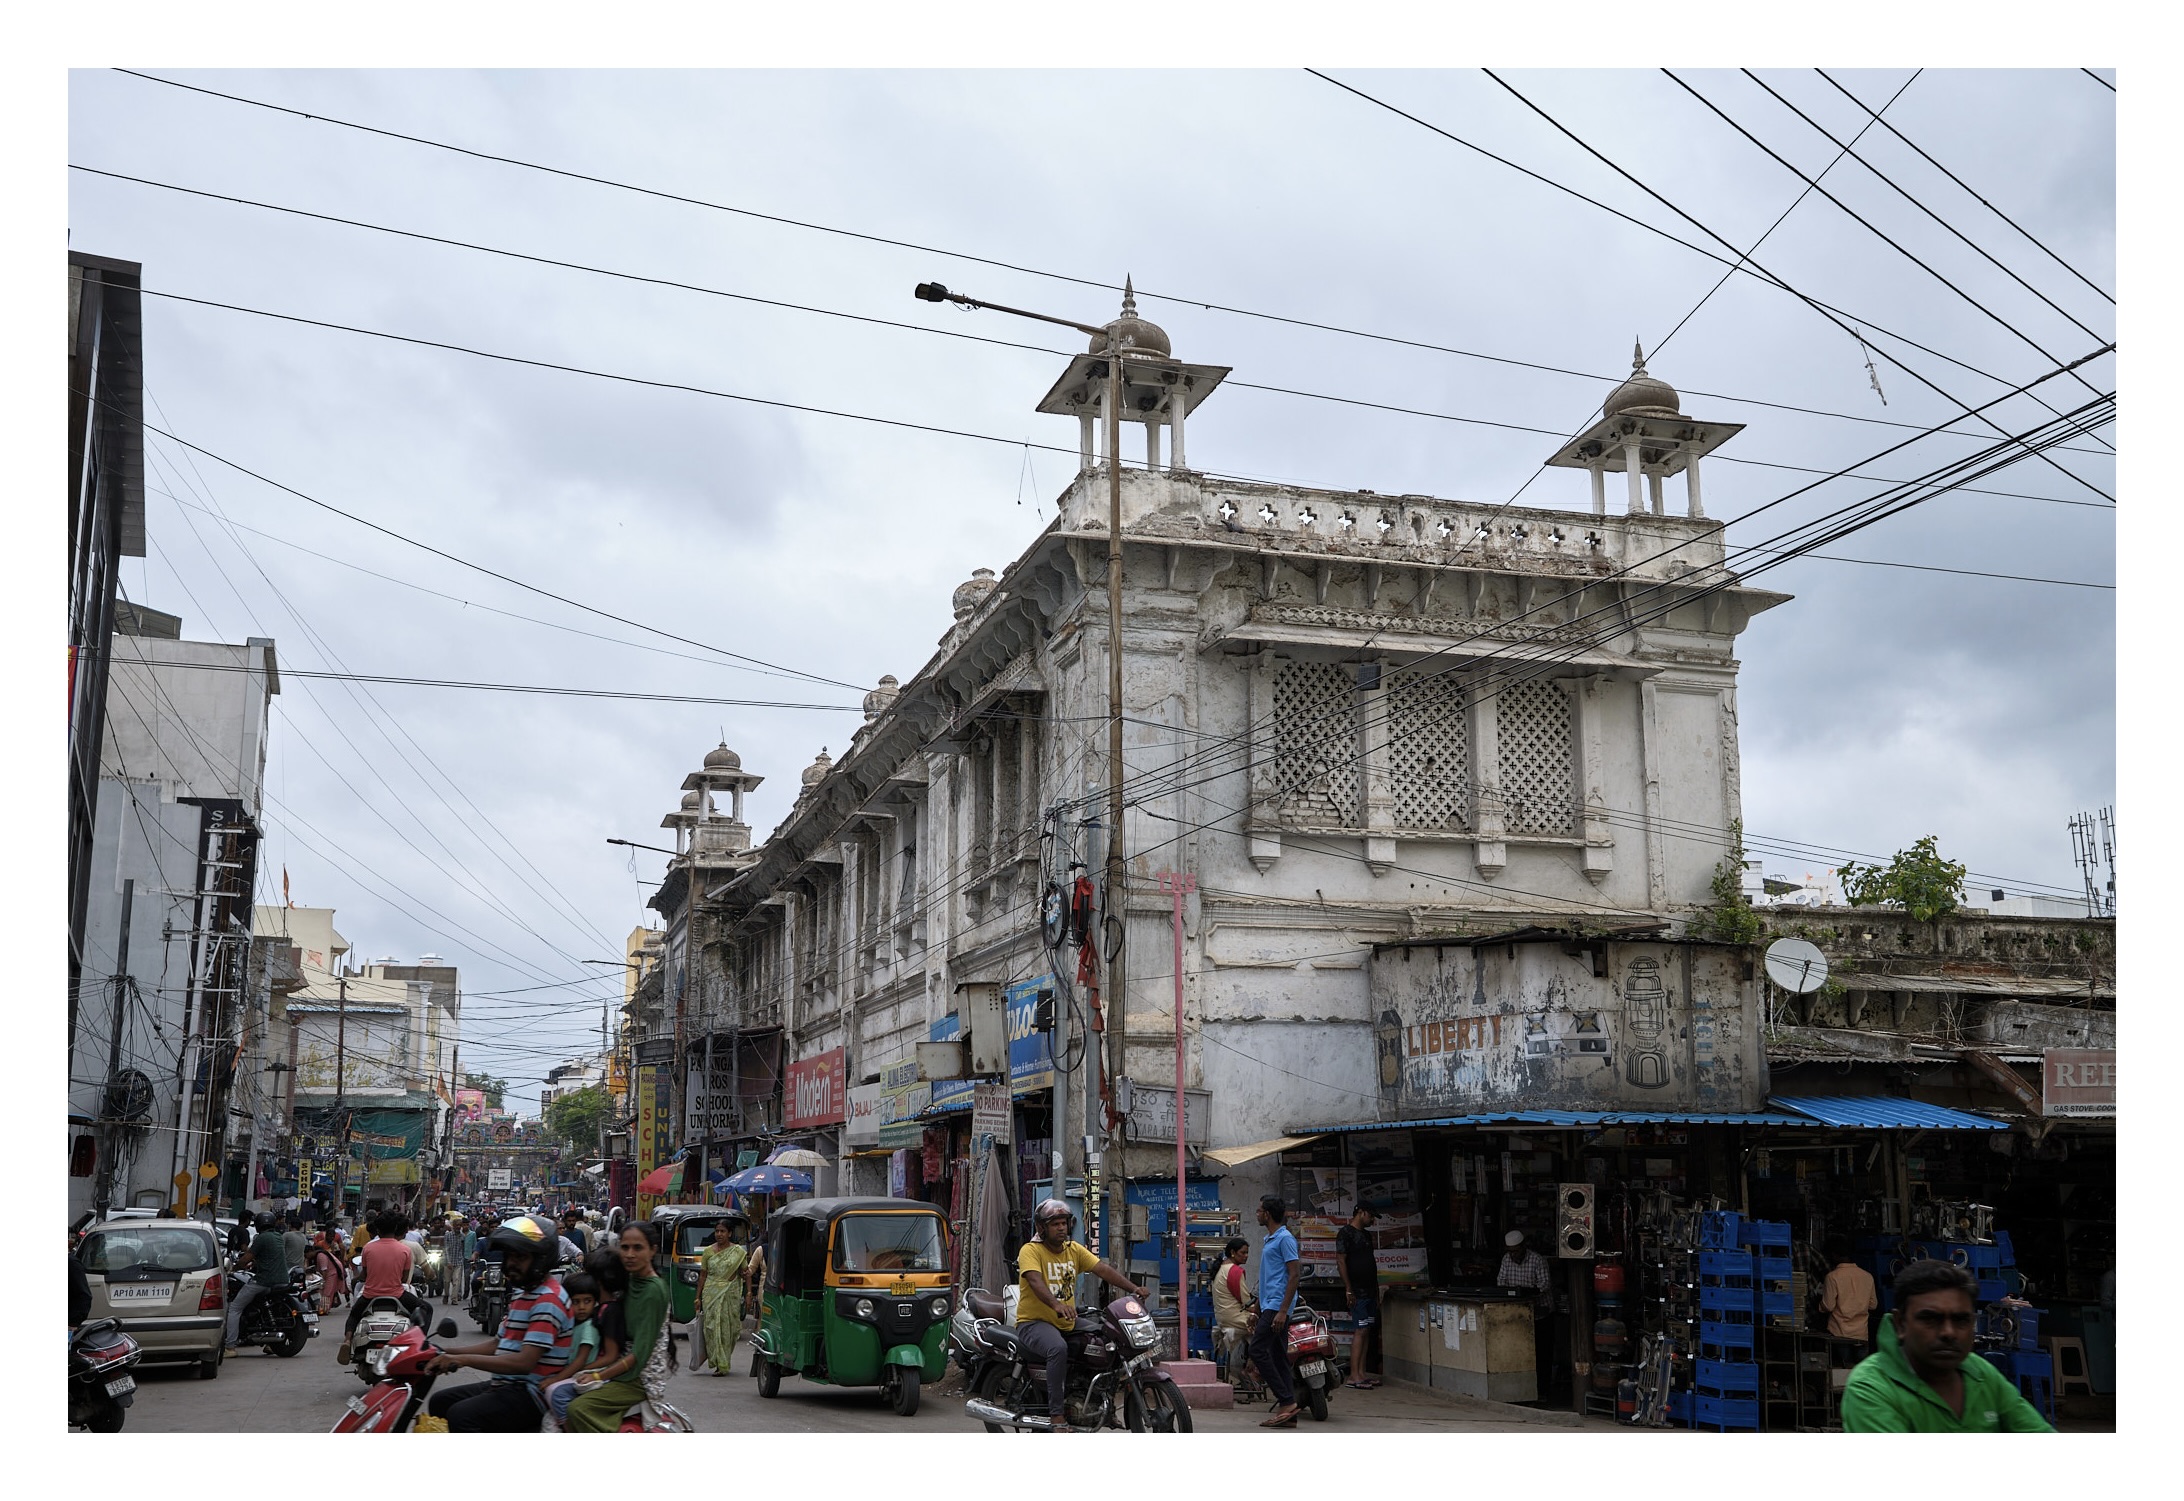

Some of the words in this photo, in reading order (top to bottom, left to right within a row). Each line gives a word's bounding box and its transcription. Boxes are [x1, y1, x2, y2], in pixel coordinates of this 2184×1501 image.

[1156, 872, 1196, 893] TRS
[1408, 1014, 1502, 1057] LIBERTY
[796, 1069, 831, 1119] Modern
[974, 1096, 983, 1110] NO
[984, 1097, 1010, 1111] PARKING
[855, 1099, 872, 1117] BAJAJ
[300, 1162, 310, 1196] SCHOO
[1160, 1187, 1199, 1196] TELEONE
[113, 1287, 134, 1298] AP10
[136, 1288, 149, 1297] AM
[152, 1288, 170, 1297] 1110
